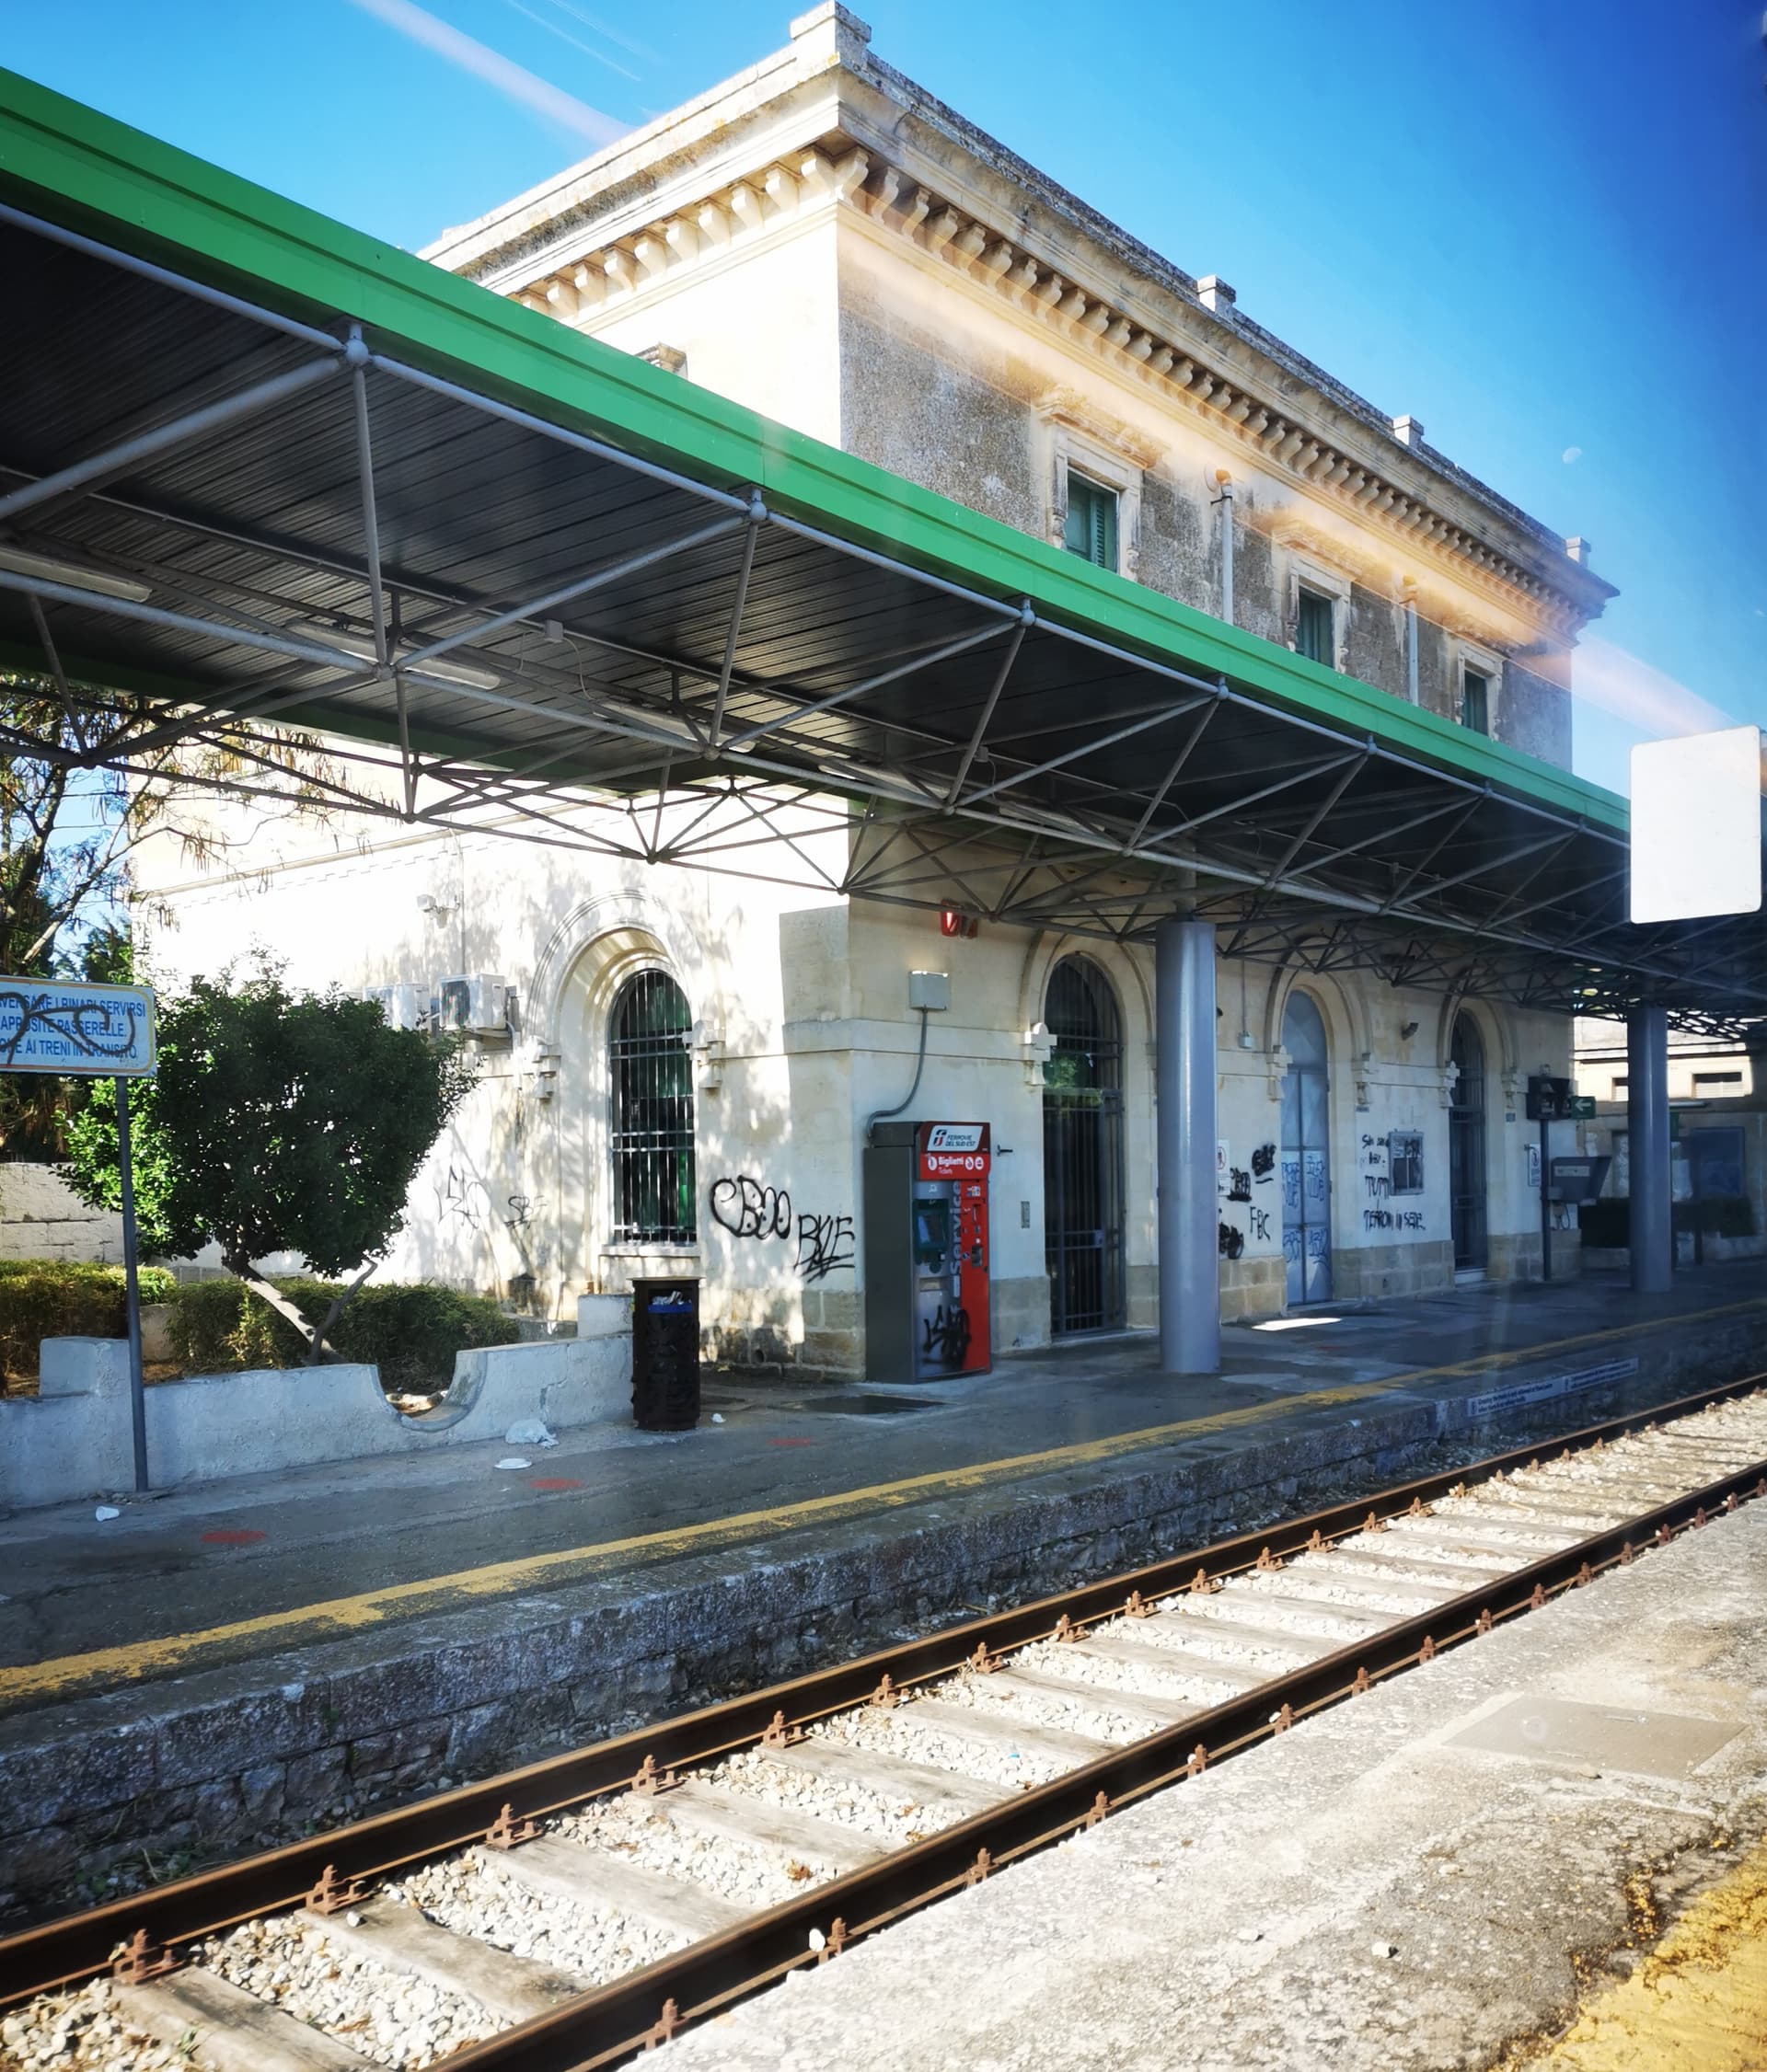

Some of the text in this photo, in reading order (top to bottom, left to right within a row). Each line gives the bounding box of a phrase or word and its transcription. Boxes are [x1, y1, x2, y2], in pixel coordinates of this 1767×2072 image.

[99, 1000, 146, 1017] SERVIRSI
[25, 1039, 36, 1054] AI
[39, 1040, 70, 1056] TRENI
[938, 1156, 964, 1168] Biglietti
